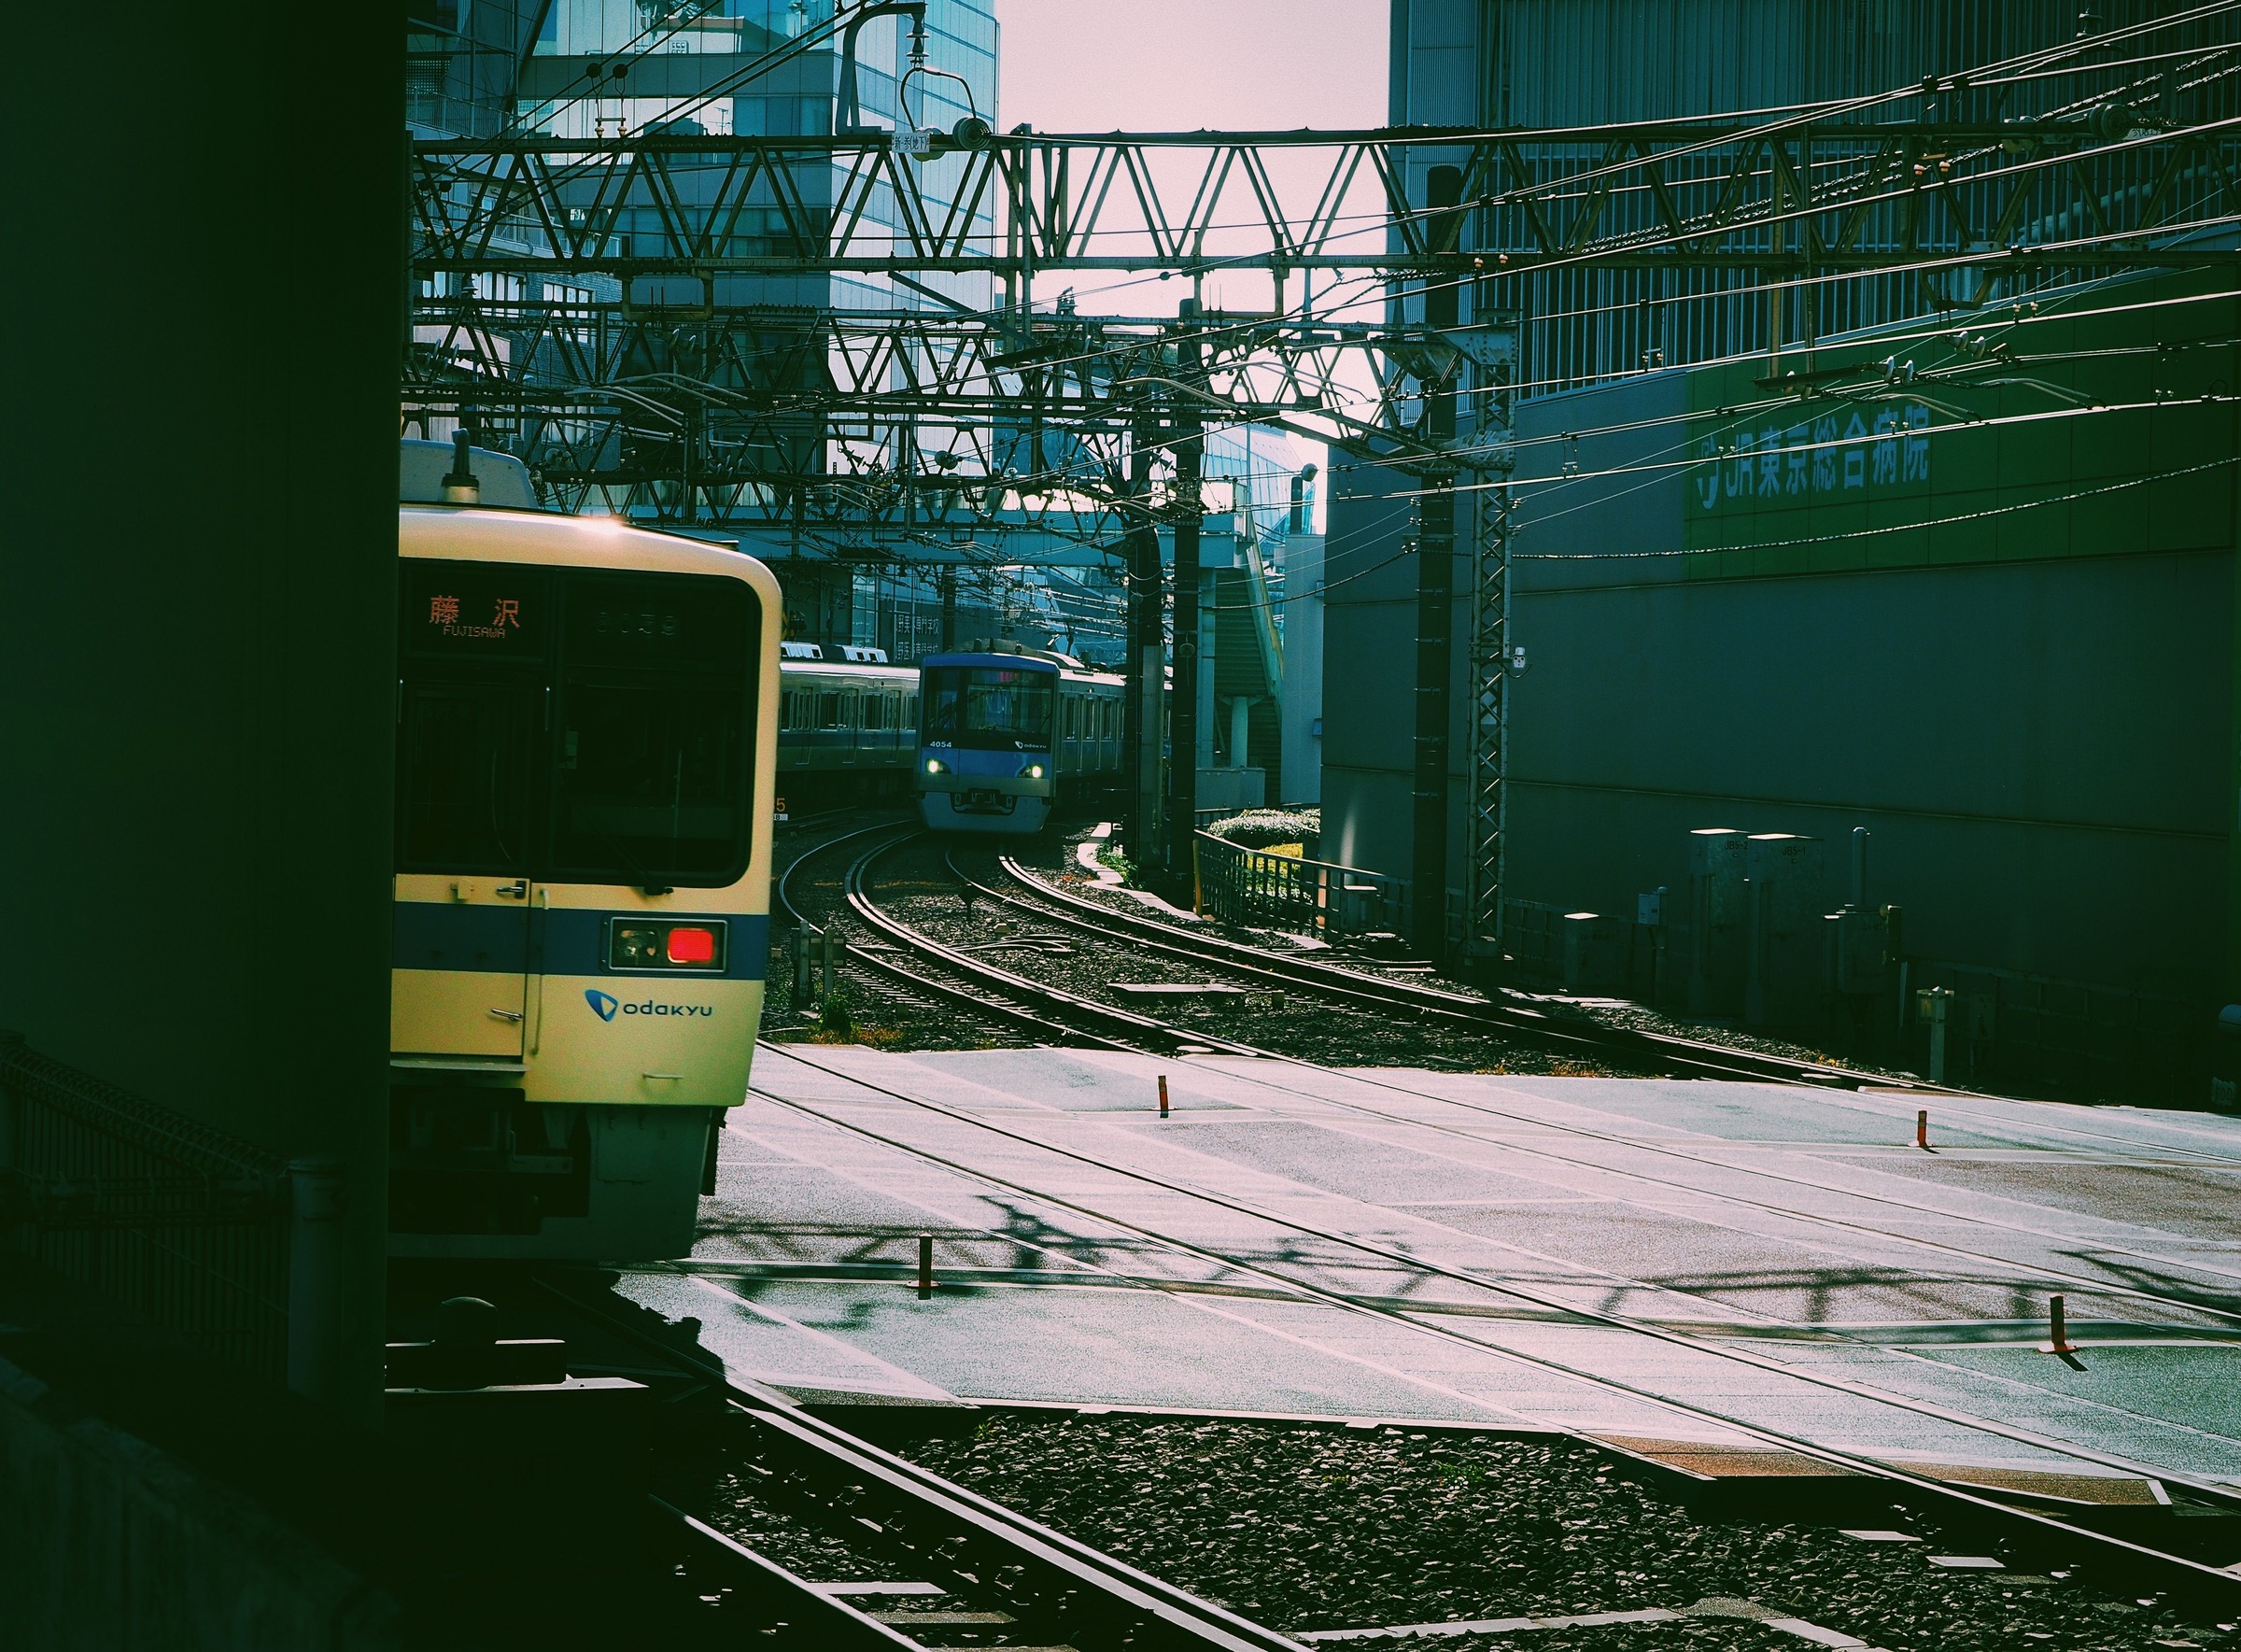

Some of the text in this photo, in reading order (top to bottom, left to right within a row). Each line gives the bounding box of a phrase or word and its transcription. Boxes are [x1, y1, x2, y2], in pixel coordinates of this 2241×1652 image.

[1726, 404, 1929, 499] JR東京総合病院
[443, 625, 506, 639] FUJISAWA
[623, 999, 712, 1017] odakyu
